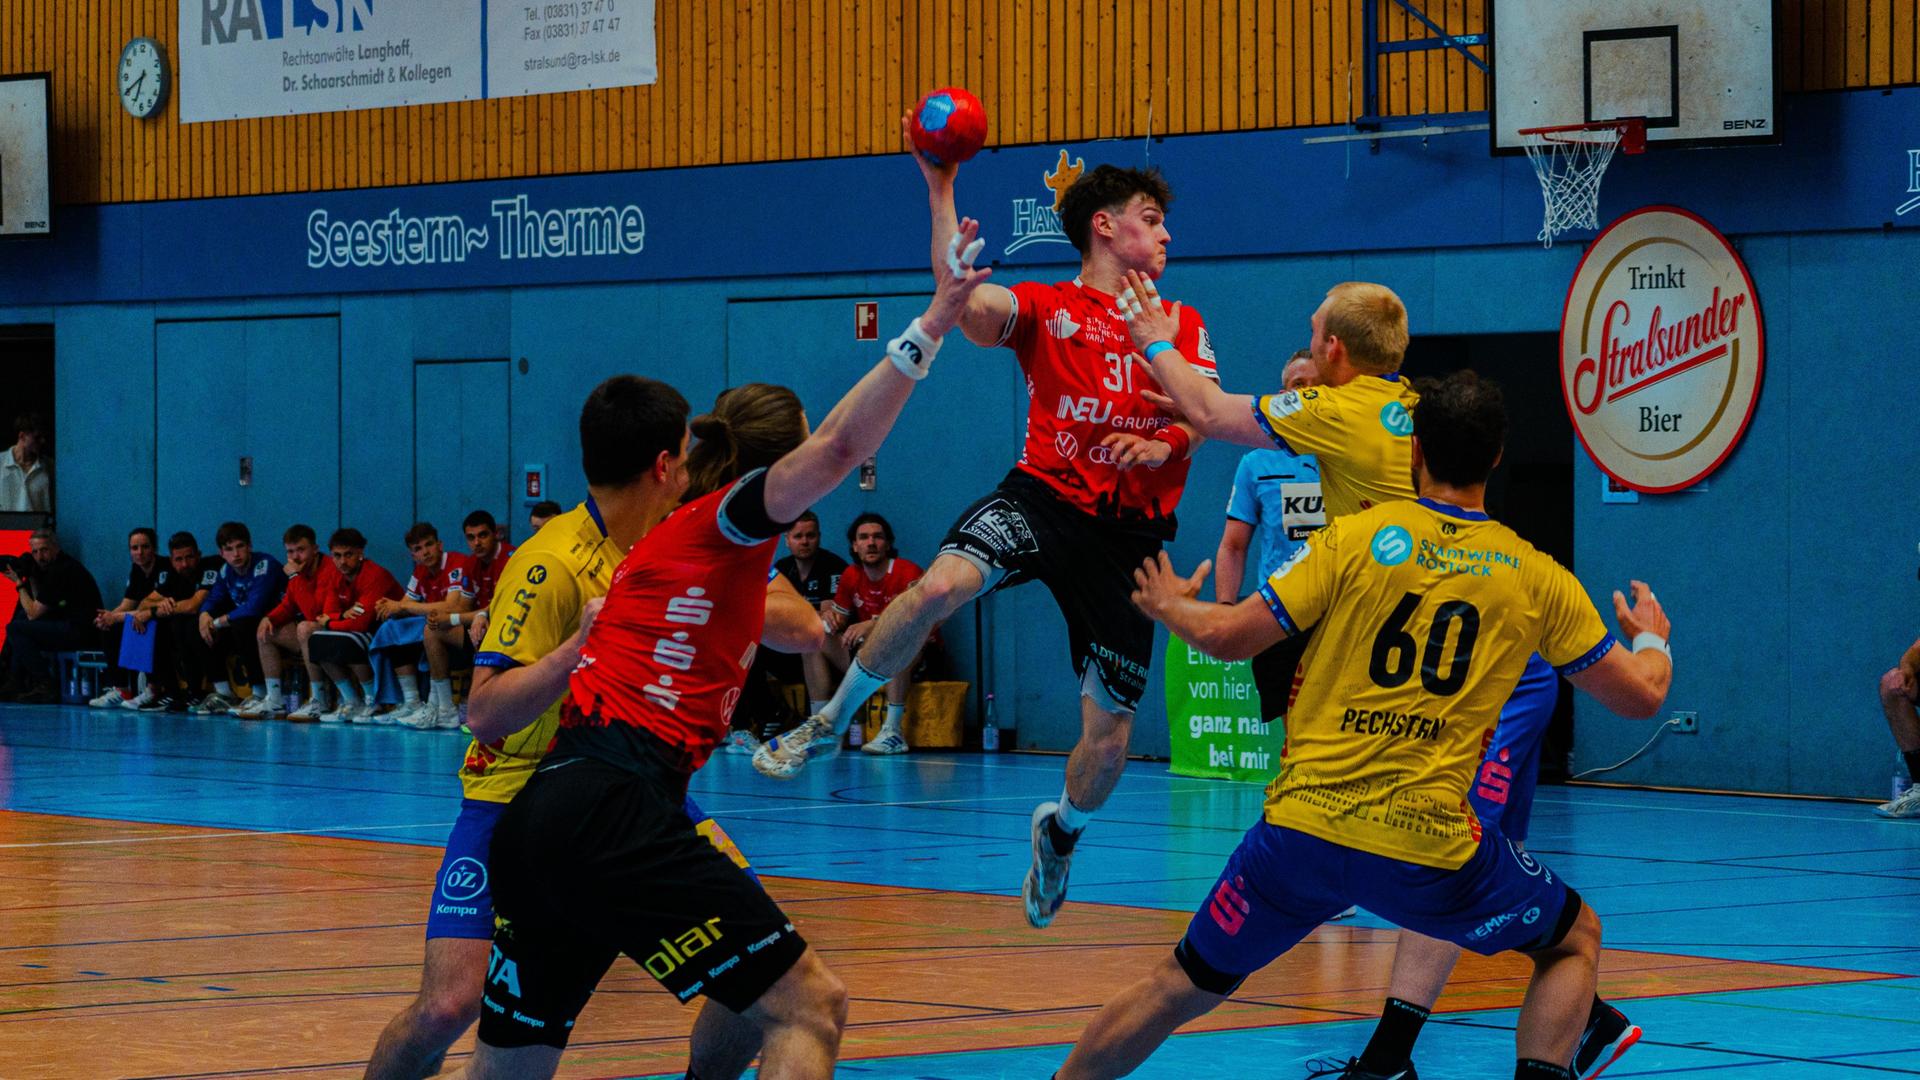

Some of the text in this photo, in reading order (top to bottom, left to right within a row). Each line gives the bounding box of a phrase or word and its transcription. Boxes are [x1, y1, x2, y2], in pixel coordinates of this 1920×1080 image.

[525, 8, 540, 21] Tel.
[581, 1, 592, 15] 37
[524, 18, 620, 42] Fax (03831) 37 47 47
[282, 39, 414, 67] Rechtsanwälte Langhoff,
[282, 64, 452, 92] Dr. Schaarschmidt & Kollegen
[1723, 119, 1766, 130] BENZ
[491, 194, 645, 259] Therme
[1628, 264, 1686, 290] Trinkt
[1573, 286, 1746, 416] Stralsunder
[1103, 352, 1133, 394] 31
[1111, 415, 1171, 431] GRUPPE
[1639, 405, 1682, 433] Bier
[1416, 554, 1492, 577] ROSTOCK
[499, 588, 537, 647] GLR
[1369, 592, 1480, 697] 60
[1188, 677, 1251, 700] von hier
[1189, 715, 1232, 738] ganz
[1209, 743, 1270, 770] bei mir
[436, 903, 478, 917] Kempa
[708, 955, 740, 978] Kempa
[747, 931, 781, 954] Kempa
[512, 1010, 545, 1028] Kempa
